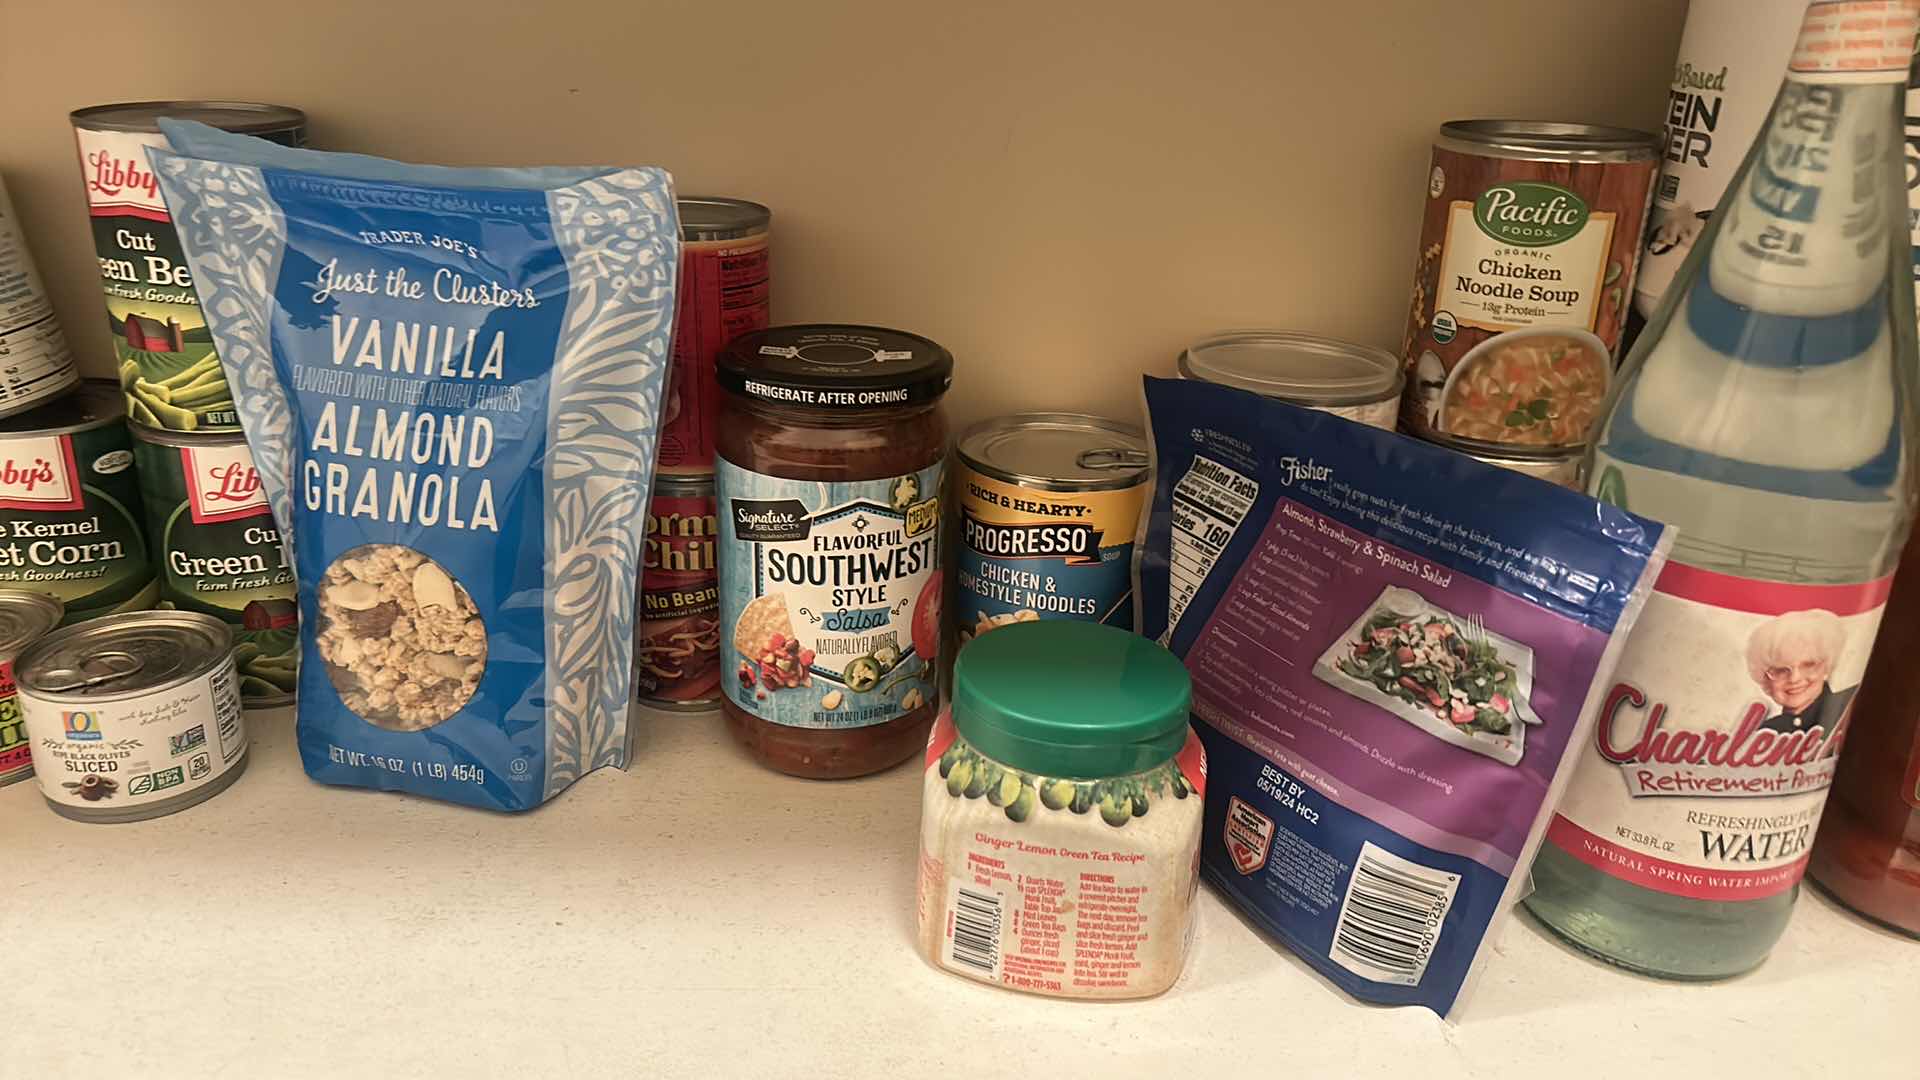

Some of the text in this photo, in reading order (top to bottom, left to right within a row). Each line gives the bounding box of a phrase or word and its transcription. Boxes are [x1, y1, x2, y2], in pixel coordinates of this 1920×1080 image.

[1485, 187, 1579, 226] Pacific
[116, 229, 156, 251] Cut
[360, 230, 479, 259] TRADER JOE'S
[1495, 249, 1552, 260] ORGANIC
[309, 258, 541, 308] Just the Clusters
[1478, 259, 1562, 281] Chicken
[1456, 276, 1579, 306] Noodle Soup
[1504, 304, 1545, 316] Protein
[332, 314, 505, 380] VANILLA
[292, 365, 353, 397] FLAVORED
[354, 374, 385, 400] WITH
[389, 378, 425, 405] OTHER
[428, 382, 473, 408] NATURAL
[745, 380, 908, 405] REFRIGERATE AFTER OPENING
[312, 401, 494, 468] ALMOND
[1280, 456, 1333, 486] Fisher
[303, 459, 499, 532] GRANOLA
[970, 483, 1085, 517] RICH & HEARTY
[1229, 475, 1257, 500] Facts
[10, 517, 100, 538] Kernel
[738, 508, 796, 529] Signature
[755, 523, 796, 531] SELECT
[1400, 504, 1420, 520] fresh
[1453, 524, 1468, 537] the
[1505, 548, 1525, 558] and
[813, 529, 902, 551] FLAVORFUL
[966, 520, 1086, 553] PROGRESSO
[1203, 523, 1230, 547] 160
[1282, 504, 1316, 532] Almond,
[1318, 519, 1360, 554] Strawberry
[1363, 541, 1374, 555] &
[1376, 546, 1419, 575] Spinach
[1421, 565, 1451, 588] Salad
[28, 540, 125, 566] Corn
[170, 550, 267, 577] Green
[768, 537, 932, 587] SOUTHWEST
[1103, 551, 1121, 562] SOUP
[23, 566, 108, 581] Goodness!
[195, 575, 270, 592] Farm Fresh
[980, 561, 1056, 593] CHICKEN &
[645, 594, 669, 609] No
[832, 585, 887, 607] STYLE
[960, 569, 1096, 615] HOMESTYLE NOODLES
[826, 608, 885, 632] Salsa
[816, 636, 862, 655] NATURALLY
[65, 760, 118, 772] SLICED
[98, 751, 130, 760] OLIVES
[328, 744, 345, 763] NET
[389, 758, 405, 773] OZ
[413, 761, 424, 777] (1
[427, 763, 447, 781] LB)
[452, 765, 484, 785] 454g
[1261, 764, 1306, 800] BEST BY
[1371, 748, 1396, 769] Drizzle
[1397, 764, 1416, 777] with
[1418, 770, 1454, 795] dressing.
[1638, 769, 1788, 793] Retirement
[1256, 777, 1320, 825] 05/19/24 HC2
[1687, 808, 1795, 830] REFRESHINGLY
[975, 832, 1146, 864] Ginger Lemon Green Tea Recipe
[1616, 825, 1632, 838] NET
[1631, 832, 1648, 845] 33.8
[1662, 841, 1675, 851] OZ
[1699, 824, 1809, 862] WATER
[1584, 839, 1752, 889] NATURAL SPRING WATER
[1080, 882, 1092, 891] Add
[1415, 932, 1435, 966] 70690
[1426, 895, 1449, 928] 02385
